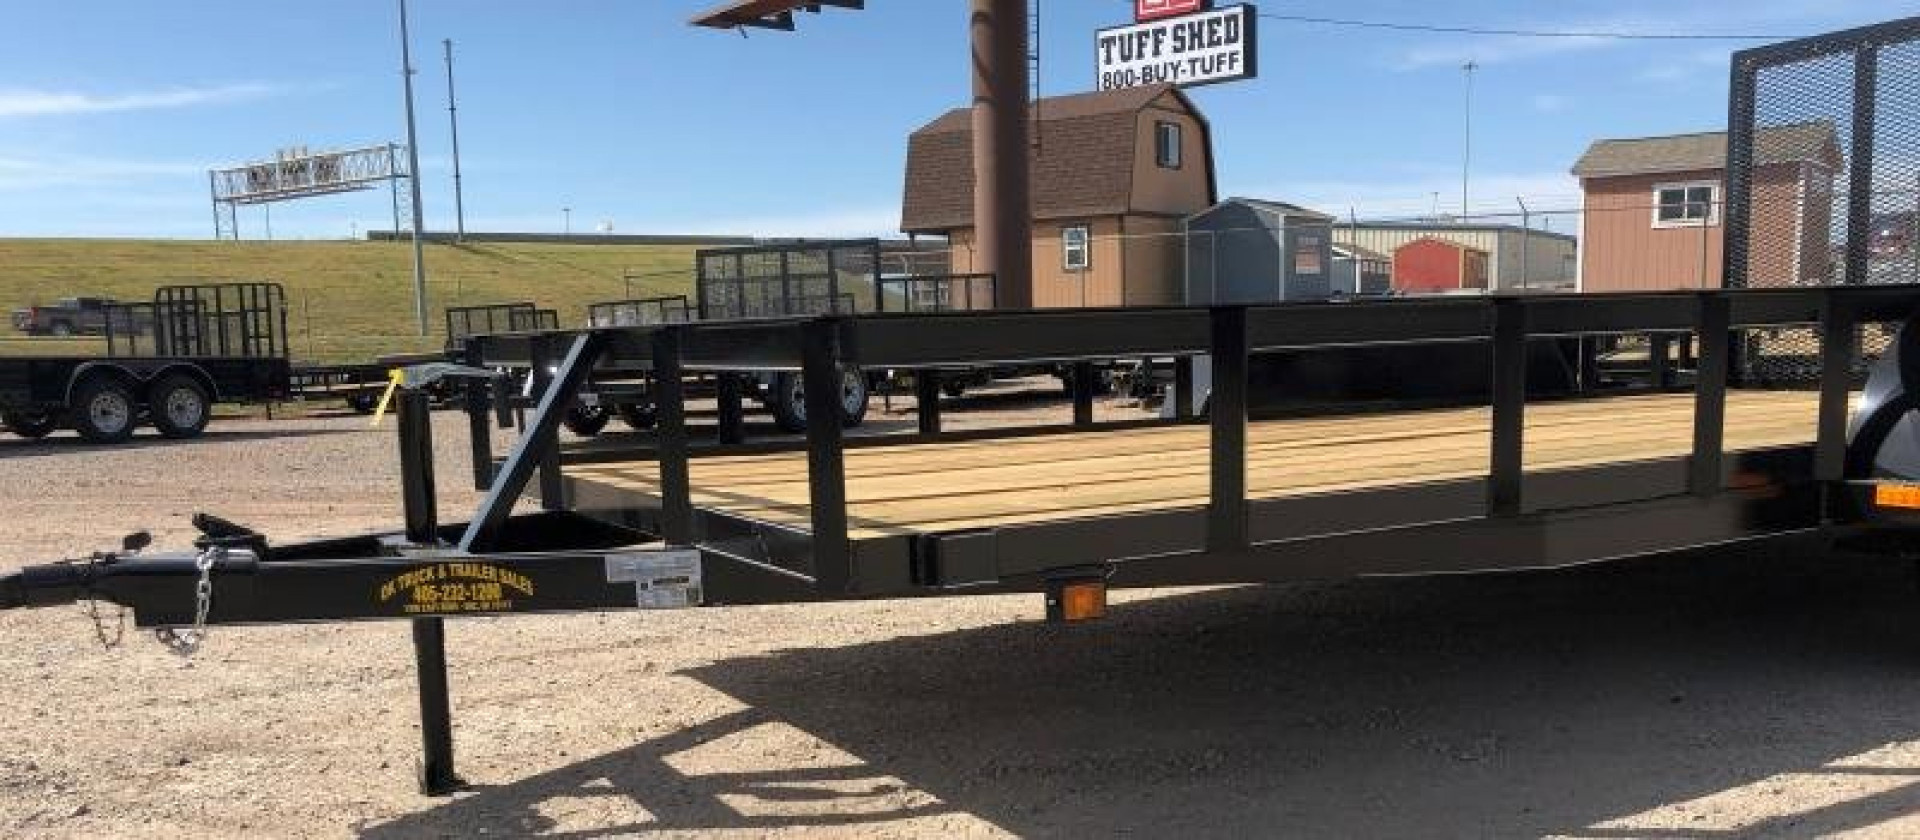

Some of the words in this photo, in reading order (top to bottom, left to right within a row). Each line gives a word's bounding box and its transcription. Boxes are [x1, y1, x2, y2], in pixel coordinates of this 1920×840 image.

[1100, 27, 1167, 66] TUFF
[1172, 13, 1239, 54] SHED
[1103, 50, 1239, 89] 800-BUY-TUFF
[398, 566, 435, 590] TRUCK
[450, 562, 498, 581] TRAILER
[499, 566, 535, 596] SALES
